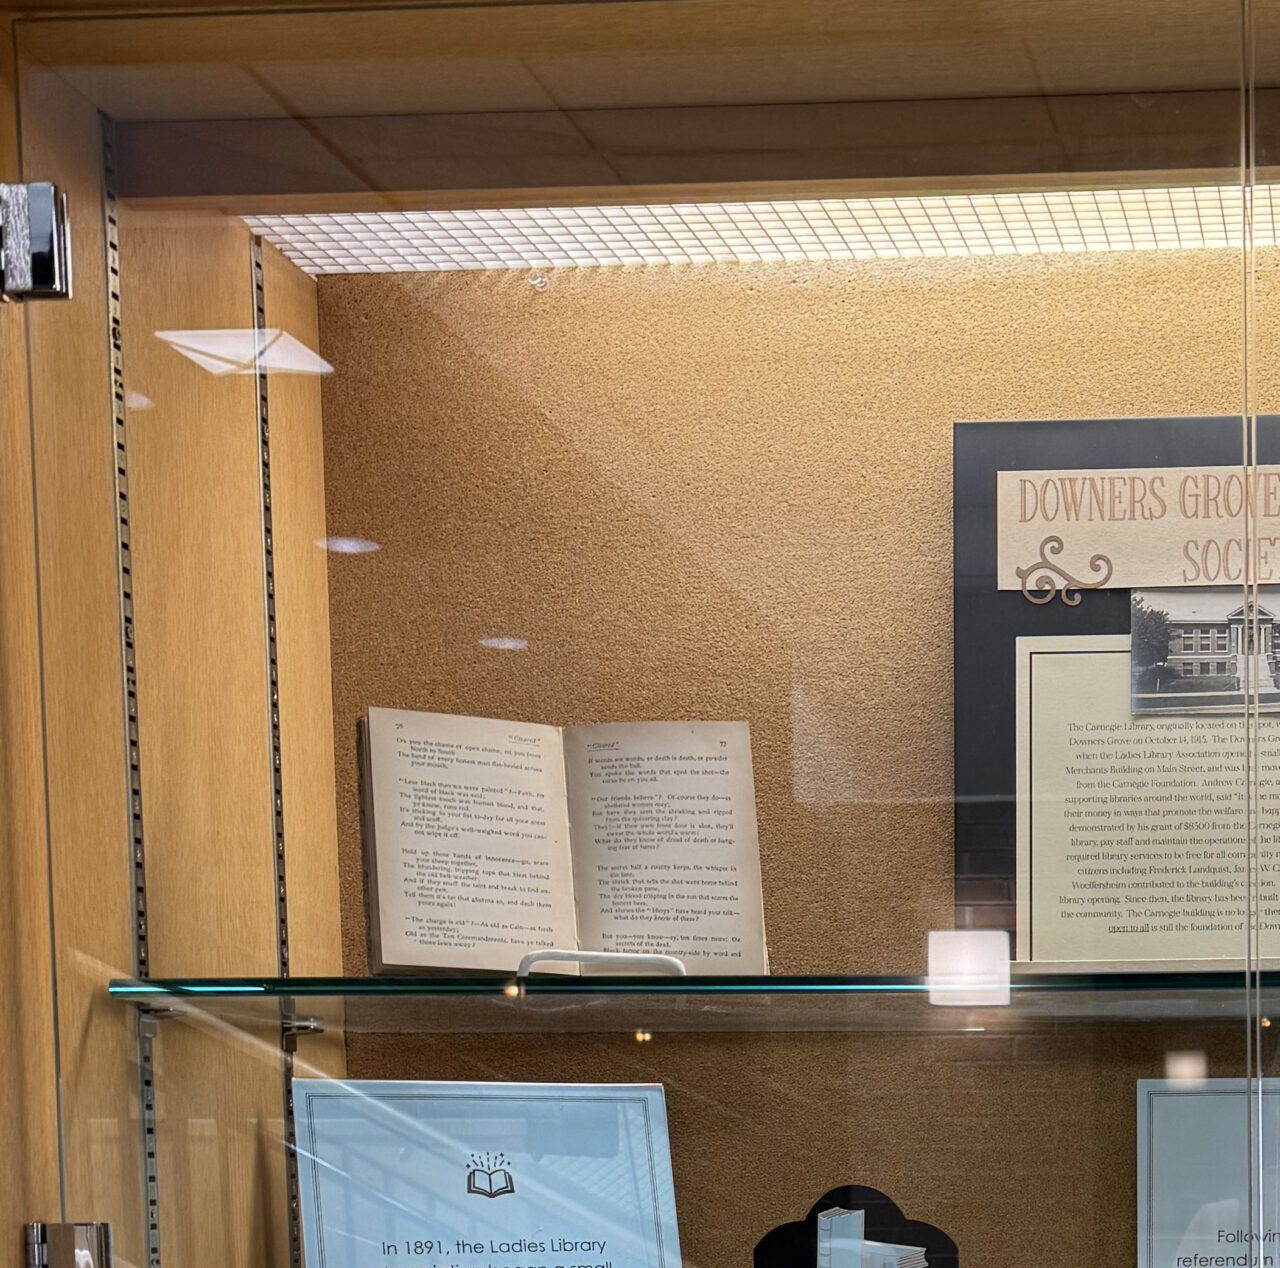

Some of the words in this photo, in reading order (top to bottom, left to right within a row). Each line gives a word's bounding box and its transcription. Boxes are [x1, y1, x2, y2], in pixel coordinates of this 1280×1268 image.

[1018, 475, 1167, 523] DOWNERS
[1068, 723, 1083, 732] The
[1085, 722, 1122, 733] Carnegie
[1157, 721, 1194, 732] originally
[1196, 721, 1224, 730] located
[1176, 923, 1189, 931] the
[1190, 922, 1233, 932] foundation
[1234, 922, 1243, 931] of
[382, 1242, 397, 1255] In
[405, 1241, 449, 1255] 1891,
[456, 1240, 484, 1254] the
[490, 1239, 546, 1253] Ladies
[551, 1238, 606, 1254] Library
